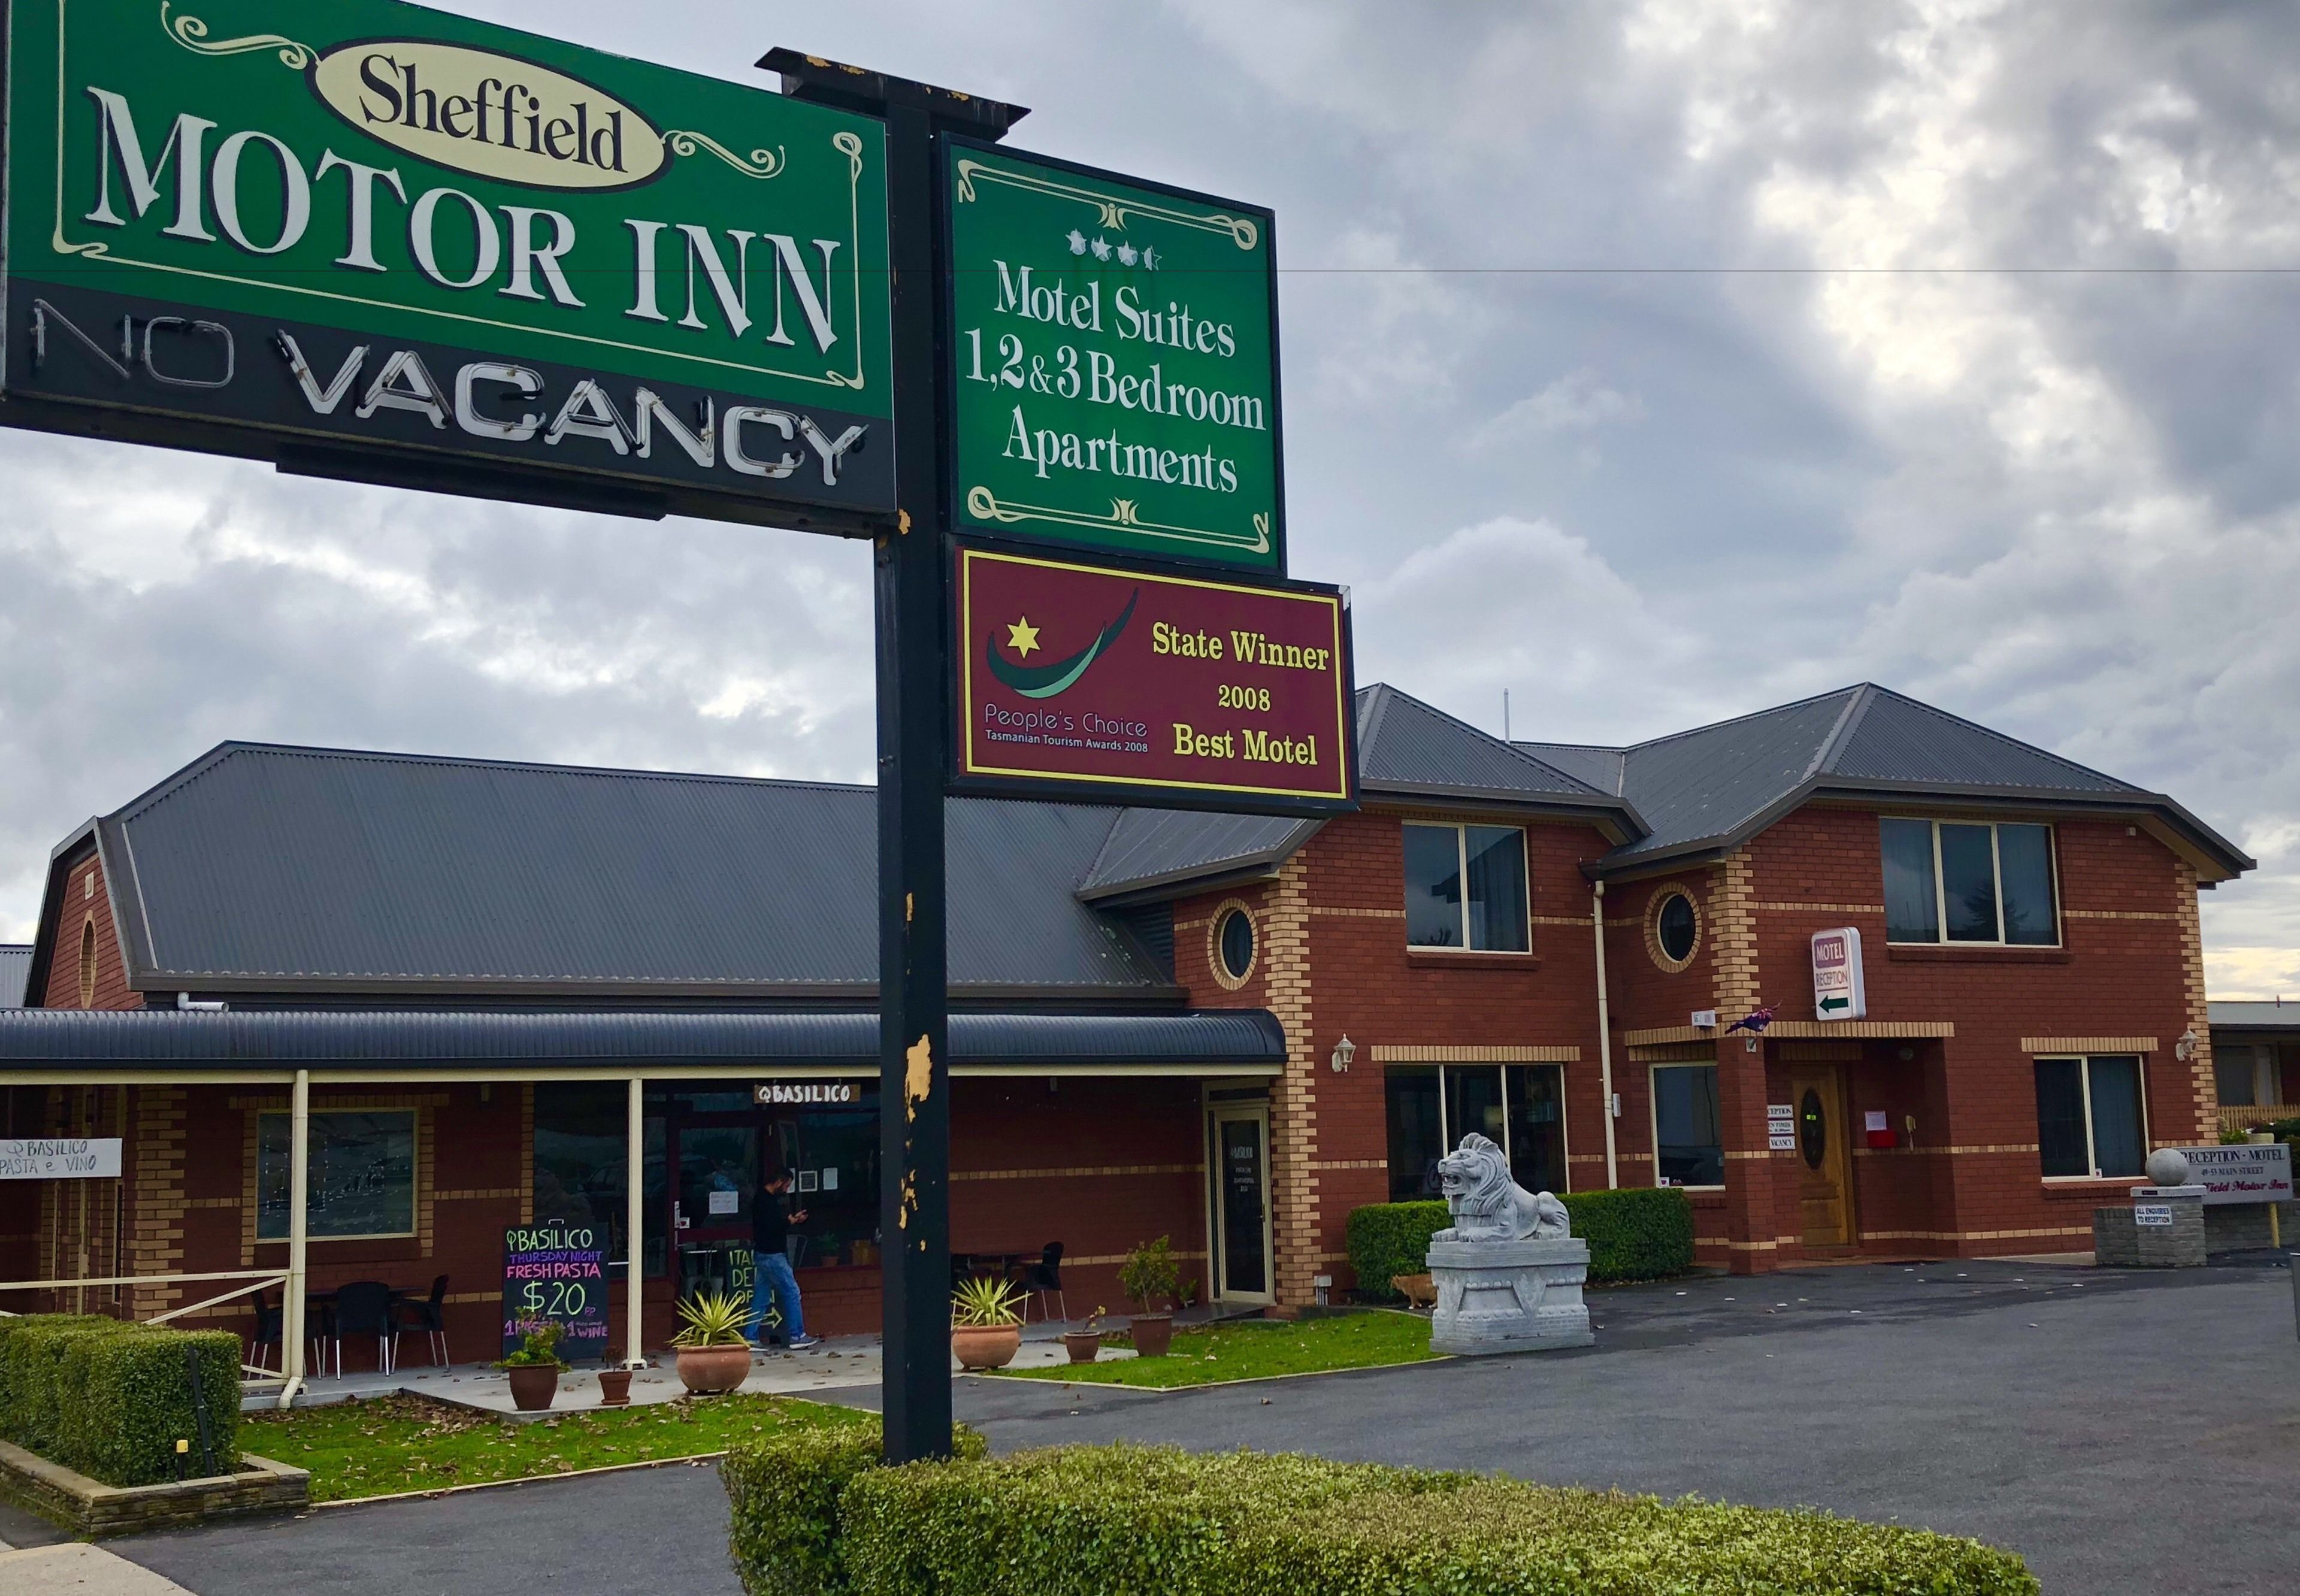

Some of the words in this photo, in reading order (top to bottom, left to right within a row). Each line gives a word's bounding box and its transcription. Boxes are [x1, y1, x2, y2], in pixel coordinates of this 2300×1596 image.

[359, 54, 628, 173] Sheffield
[85, 86, 586, 307] MOTOR
[624, 219, 841, 355] INN
[993, 259, 1104, 332] Motel
[1115, 286, 1236, 358] Suites
[30, 298, 234, 388] NO
[276, 329, 870, 486] VACANCY
[1086, 350, 1267, 431] Bedroom
[1002, 404, 1238, 493] Apartments
[1152, 620, 1223, 660] State
[1230, 630, 1329, 671] Winner
[1218, 685, 1271, 711] 2008
[985, 703, 1074, 732] People's
[1082, 713, 1148, 737] Choice
[985, 729, 1040, 744] Tasmanian
[1043, 734, 1083, 747] Tourism
[1085, 738, 1122, 751] Awards
[1124, 741, 1148, 753] 2008
[1172, 723, 1234, 758] Best
[1242, 728, 1318, 766] Motel
[1816, 943, 1844, 961] MOTEL
[1815, 970, 1848, 986] RECEPTION
[773, 1085, 851, 1103] BASILICO
[28, 1140, 88, 1156] BASILICO
[2181, 1150, 2240, 1164] RECEPTION
[2249, 1149, 2286, 1161] MOTEL
[0, 1158, 38, 1175] PASTA
[66, 1155, 96, 1171] VINO
[2219, 1167, 2238, 1176] MAIN
[2239, 1167, 2264, 1175] STREET
[2232, 1180, 2267, 1191] Motor
[2268, 1179, 2289, 1190] Inn
[518, 1228, 593, 1252] BASILICO
[510, 1251, 568, 1264] THURSDAY
[570, 1250, 603, 1262] NIGHT
[507, 1263, 552, 1279] FRESH
[554, 1262, 601, 1279] PASTA
[523, 1280, 586, 1316] $20
[577, 1325, 609, 1338] WINE
